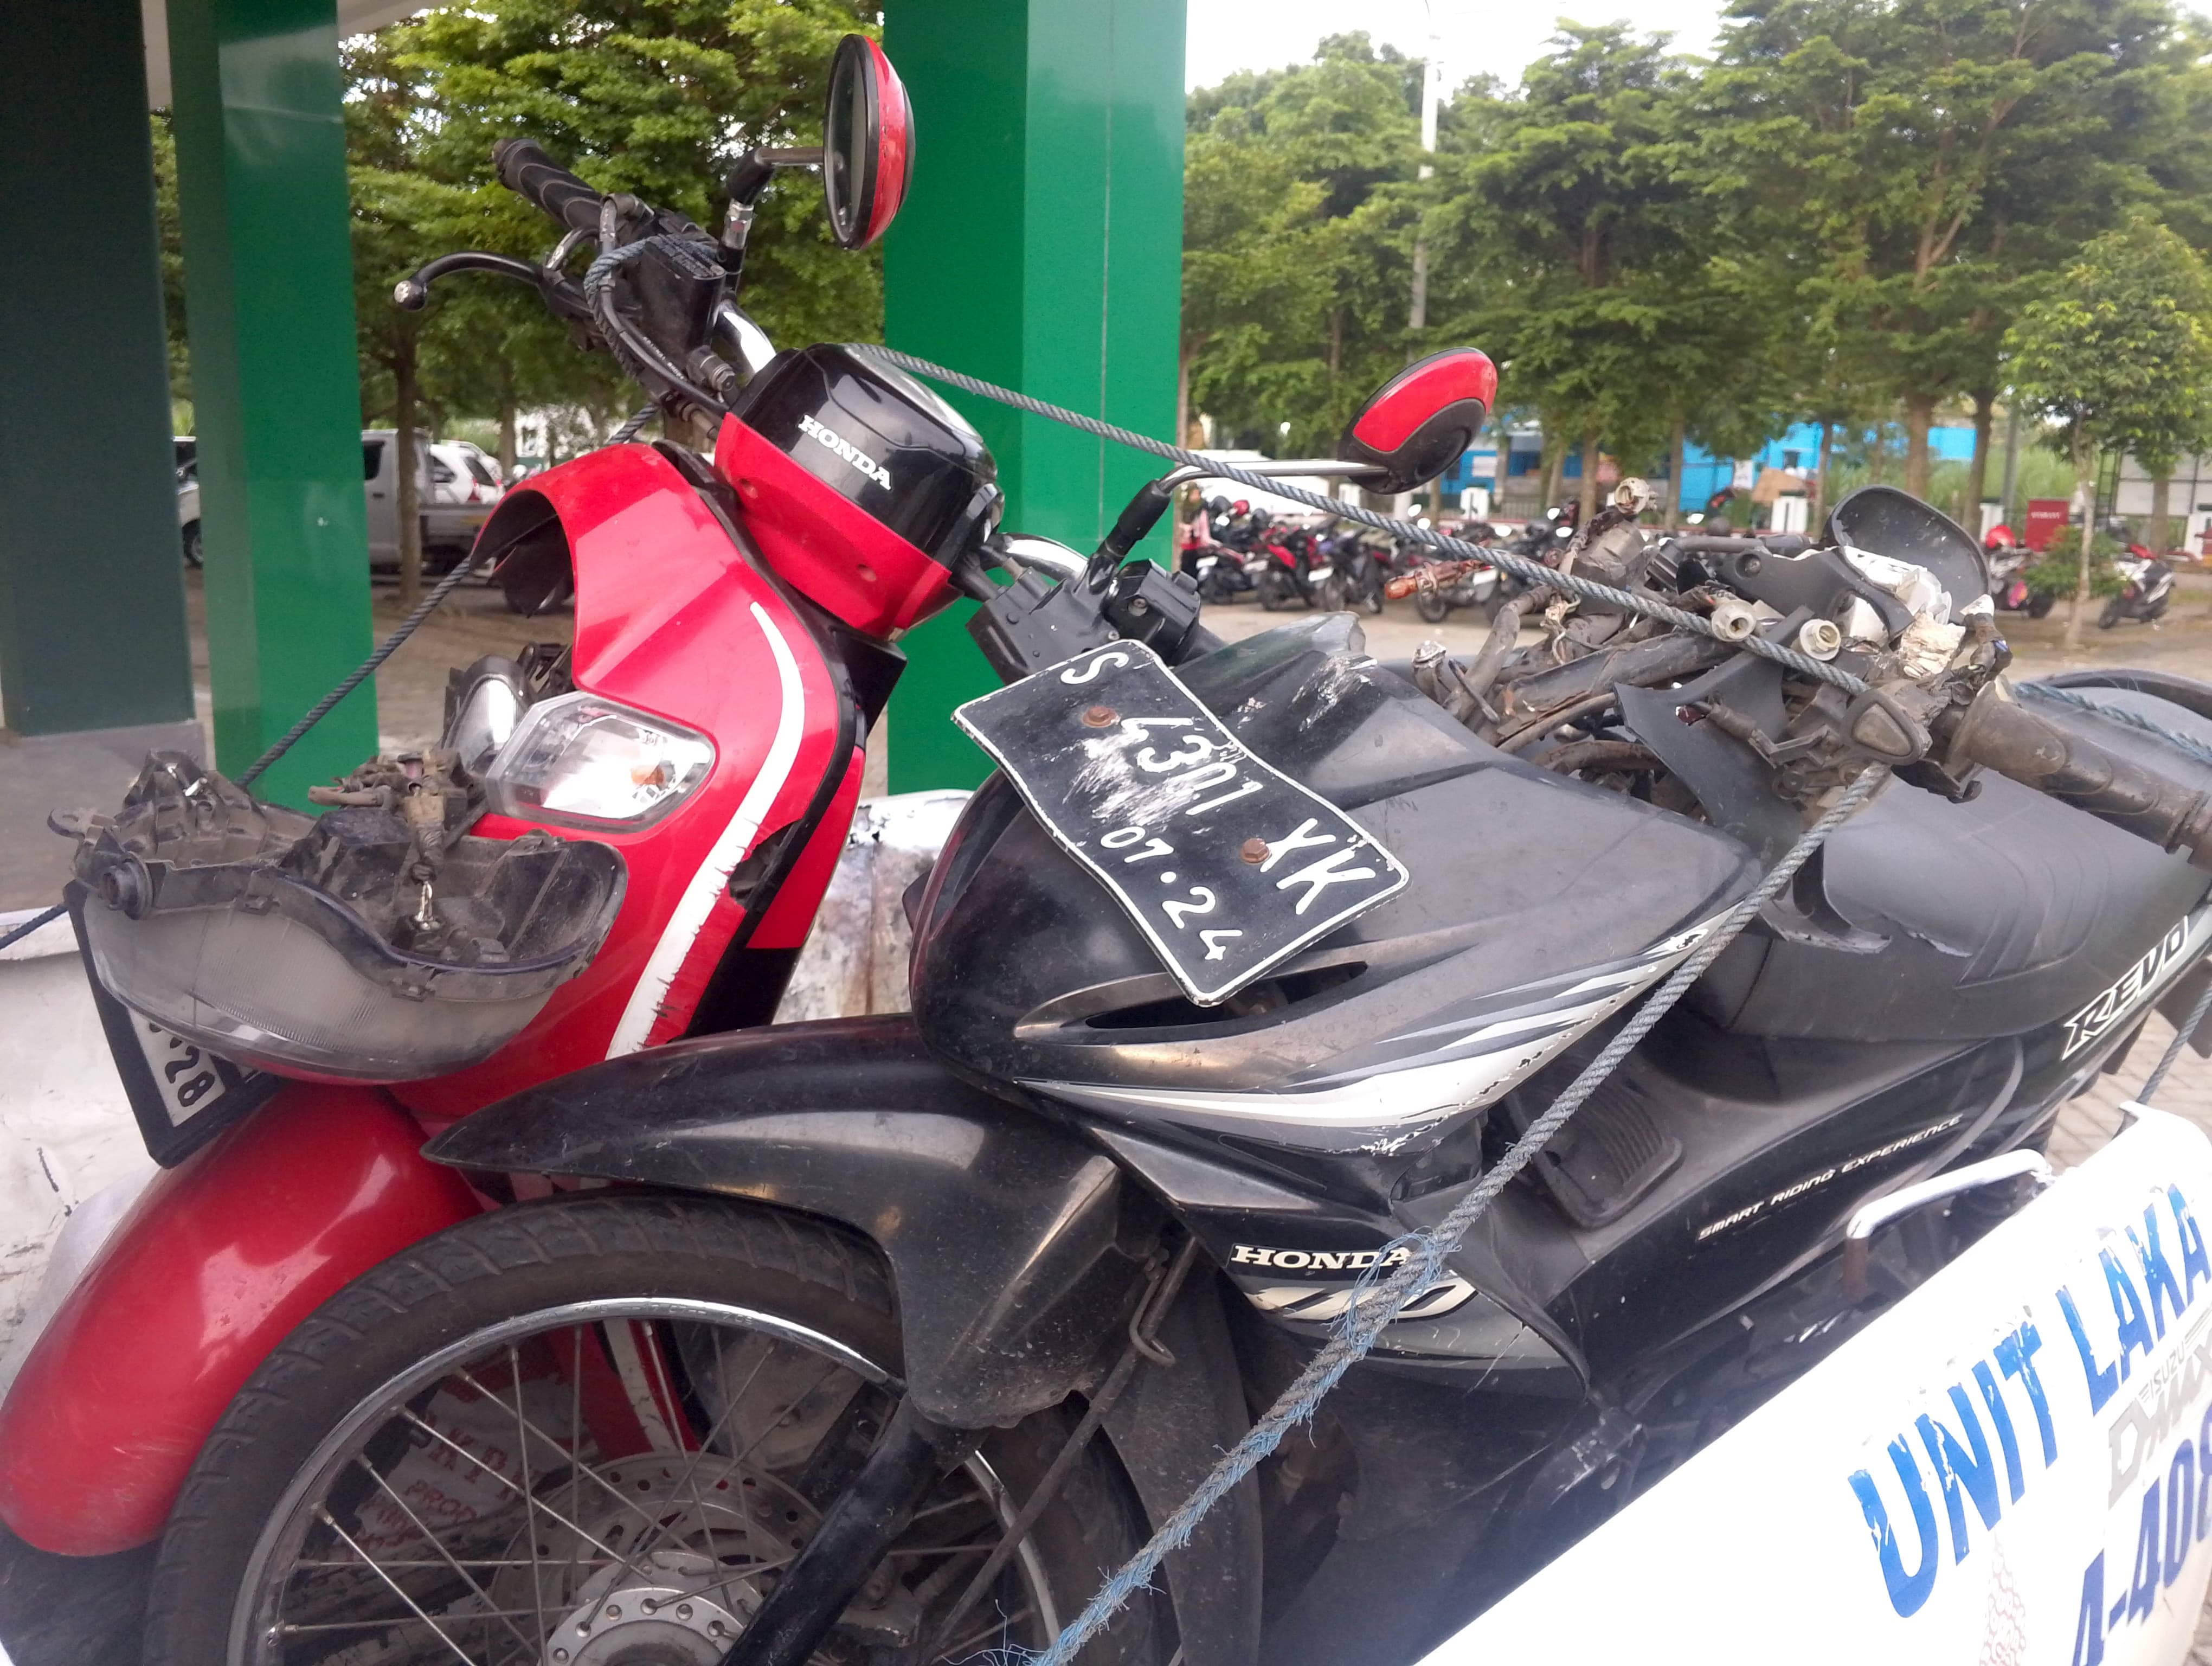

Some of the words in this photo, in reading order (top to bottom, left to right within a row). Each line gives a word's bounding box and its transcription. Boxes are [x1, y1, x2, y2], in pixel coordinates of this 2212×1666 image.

[798, 414, 891, 491] HONDA
[1060, 652, 1129, 685] S
[2061, 915, 2188, 1061] REVO
[1697, 1201, 1765, 1241] SMART
[1770, 1169, 1836, 1206] RIDING
[1841, 1113, 1964, 1173] EXPERIENCE
[1231, 1245, 1411, 1270] HONDA
[1847, 1321, 2058, 1618] UNIT
[2055, 1183, 2212, 1417] LAKA
[2149, 1341, 2185, 1399] ISUZU
